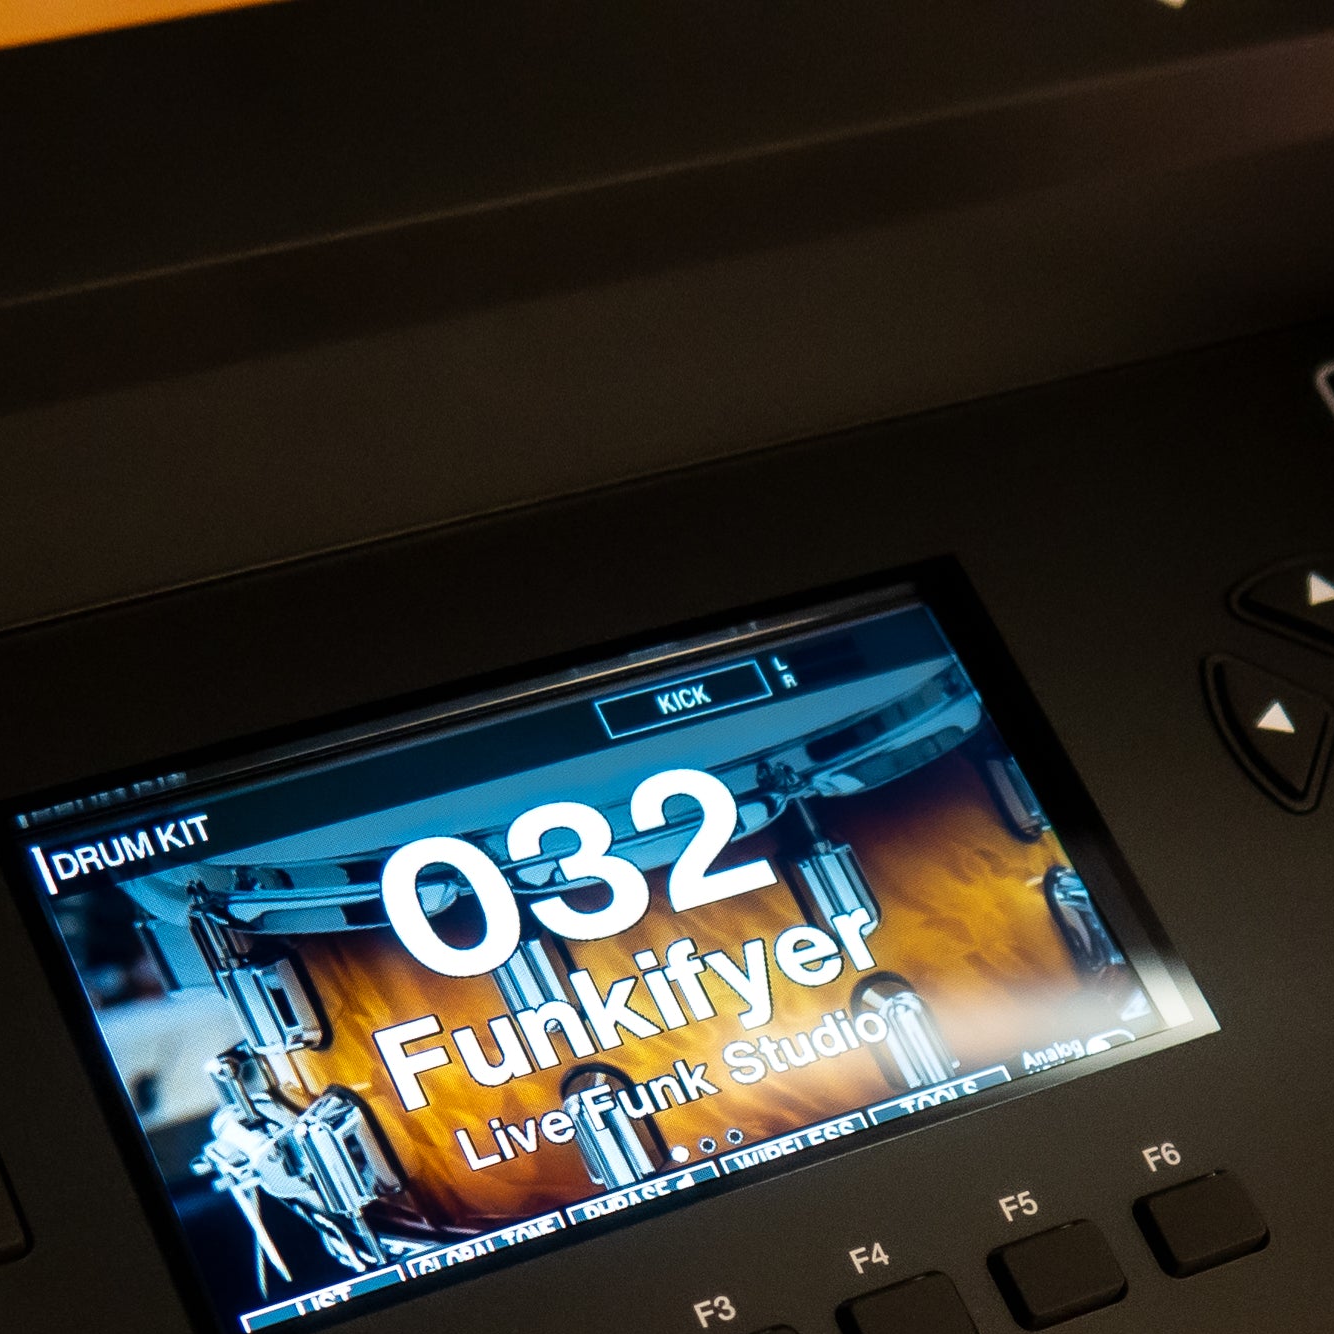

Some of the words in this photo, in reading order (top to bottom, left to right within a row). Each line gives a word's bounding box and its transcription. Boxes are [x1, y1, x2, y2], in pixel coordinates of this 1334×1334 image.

[656, 685, 711, 715] KICK
[56, 833, 156, 880] DRUM
[161, 814, 209, 847] KIT
[379, 769, 778, 977] 032
[372, 906, 880, 1112] Funkifyer
[1022, 1037, 1086, 1070] Analog
[455, 1109, 576, 1171] Live
[581, 1061, 718, 1131] Funk
[722, 1009, 889, 1085] Studio
[1142, 1142, 1183, 1173] F6
[998, 1190, 1040, 1223] F5
[848, 1241, 890, 1275] F4
[693, 1295, 737, 1329] F3
